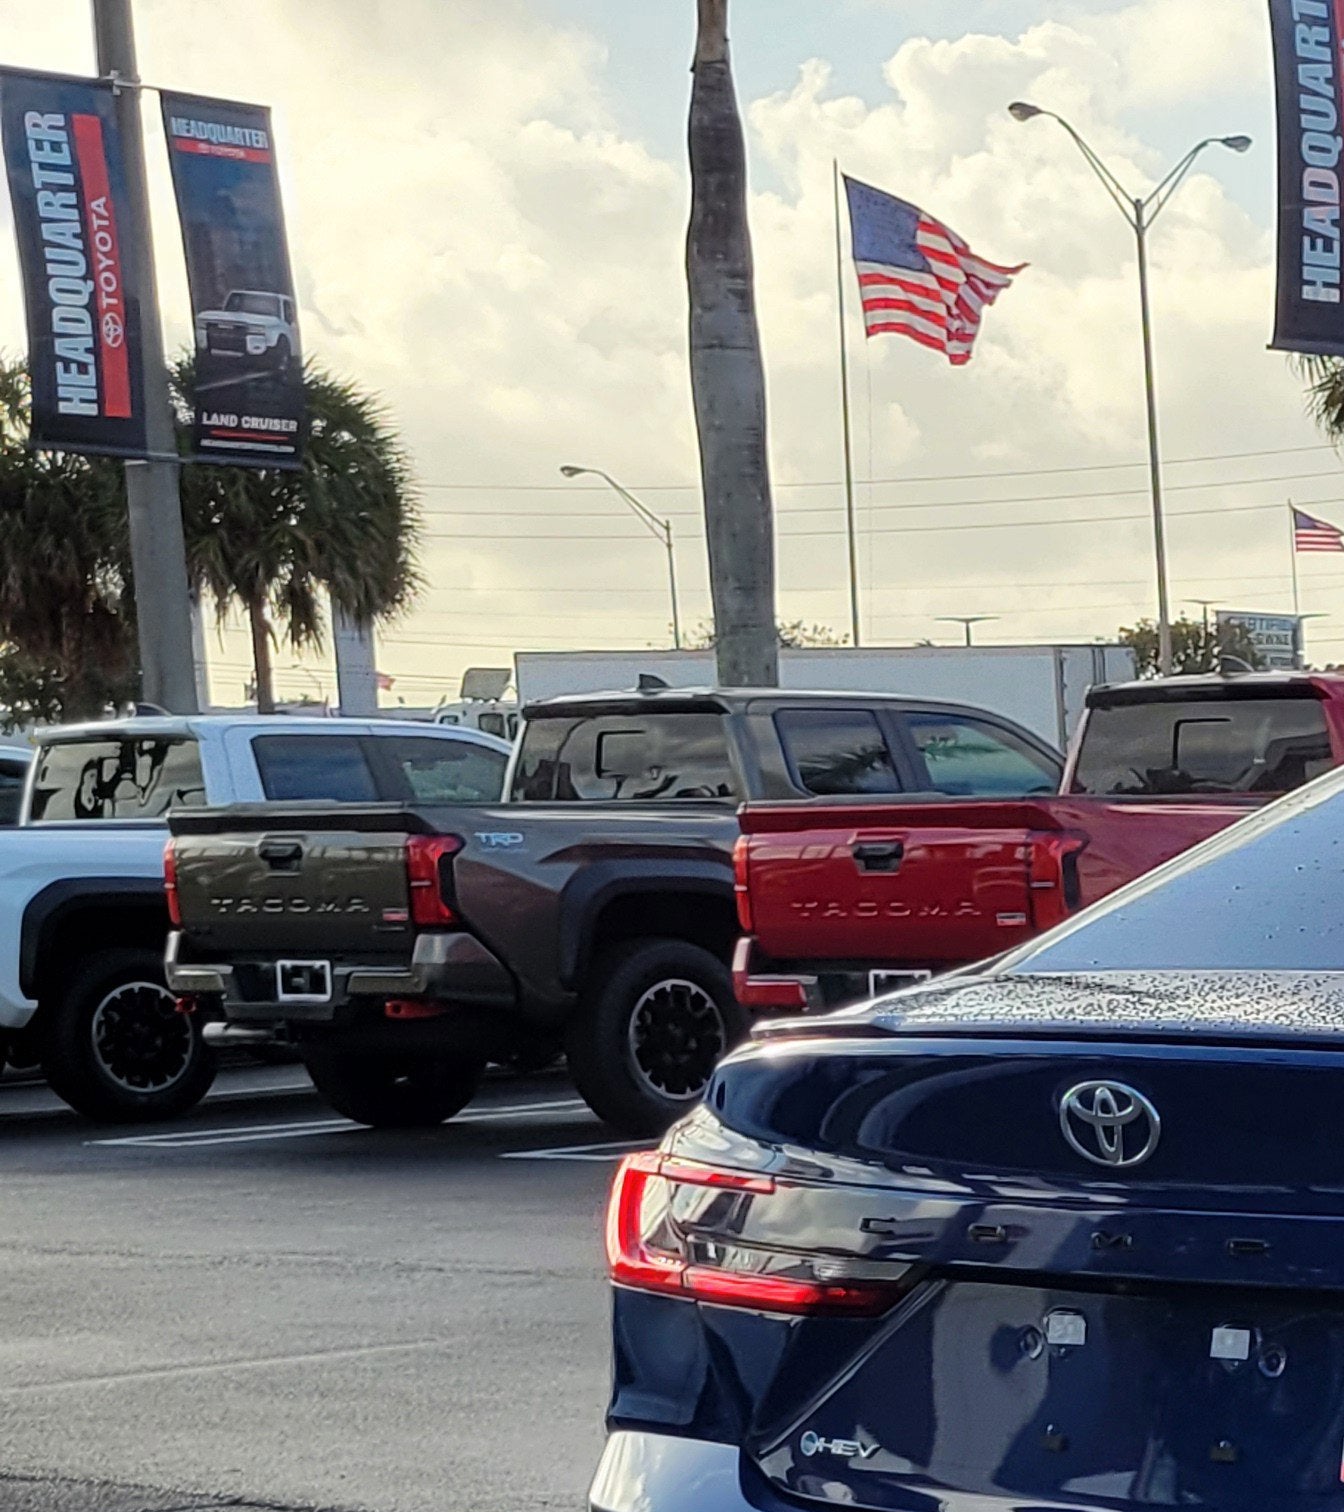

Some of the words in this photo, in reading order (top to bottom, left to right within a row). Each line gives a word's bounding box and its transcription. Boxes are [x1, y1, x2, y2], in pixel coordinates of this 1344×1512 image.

[170, 116, 269, 149] HEADQUARTER
[91, 196, 119, 309] TOYOTA
[24, 110, 99, 417] HEADQUARTER
[202, 411, 239, 428] LAND
[241, 415, 299, 432] CRUISER
[473, 831, 524, 846] TRD
[210, 898, 371, 914] TACOMA
[790, 901, 982, 917] TACOMA
[817, 1437, 881, 1459] HEV
